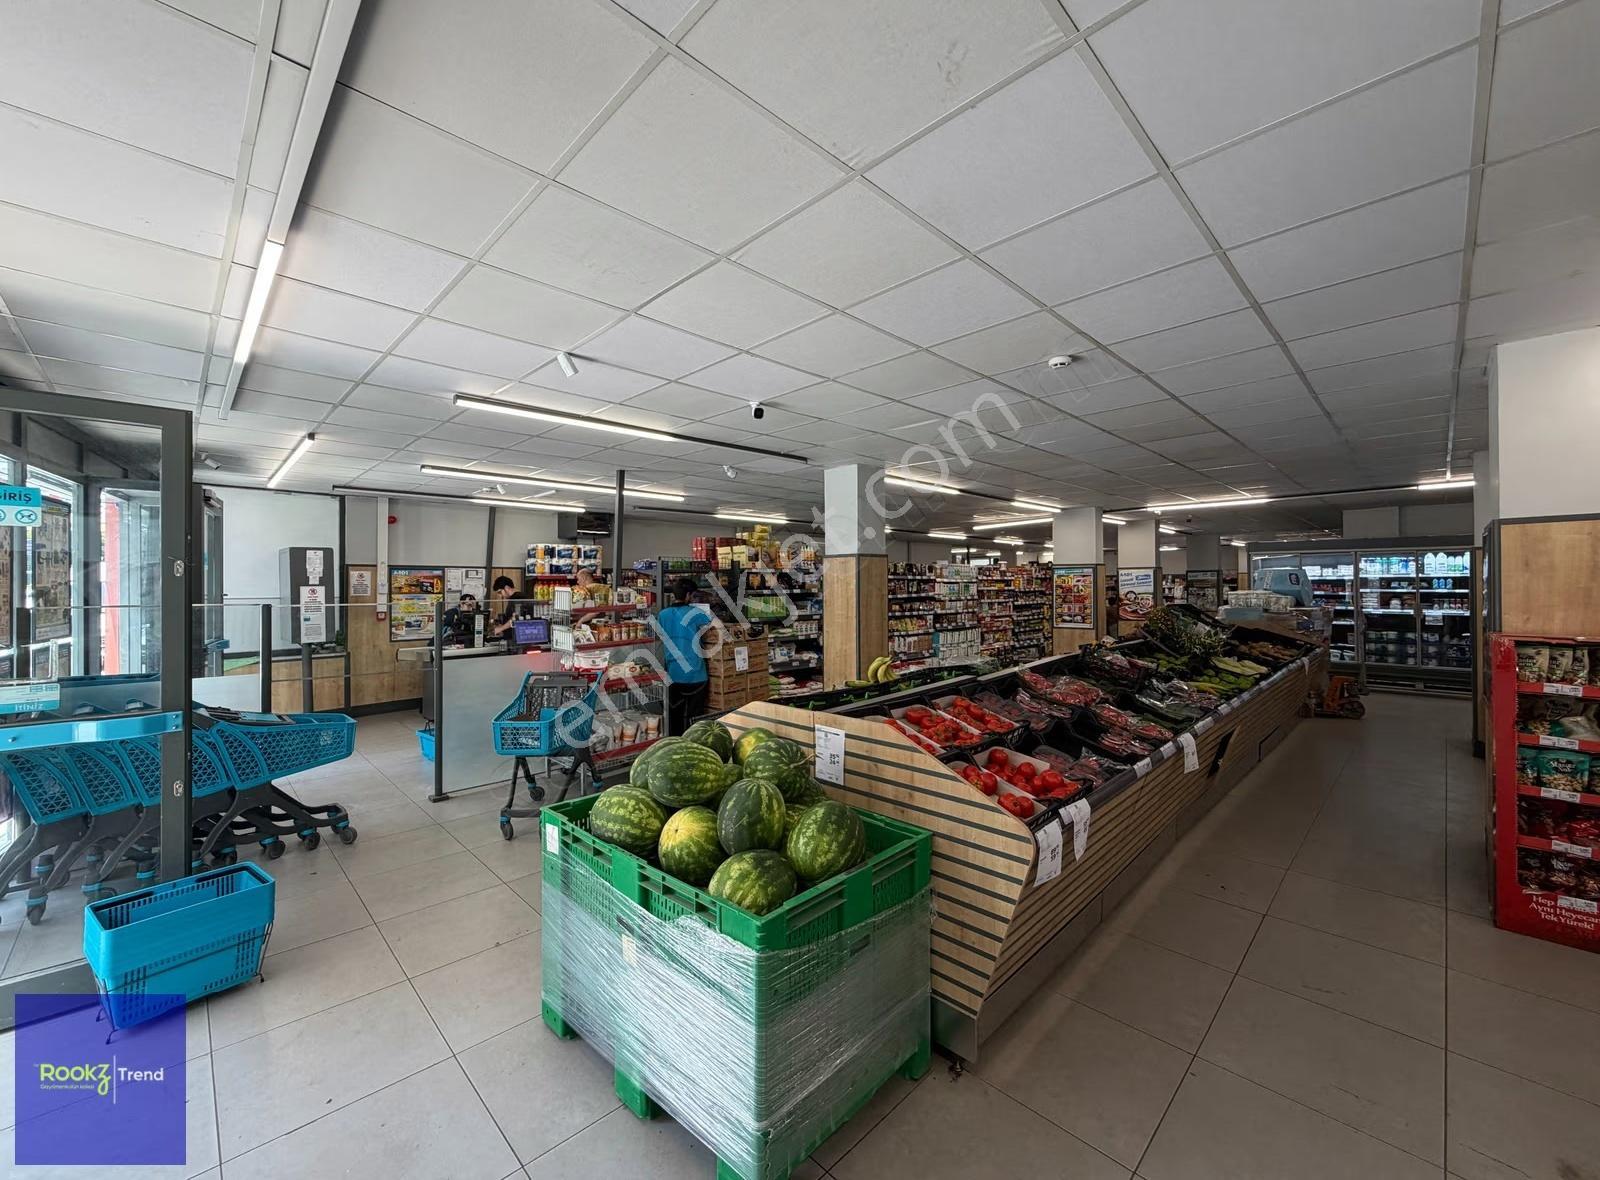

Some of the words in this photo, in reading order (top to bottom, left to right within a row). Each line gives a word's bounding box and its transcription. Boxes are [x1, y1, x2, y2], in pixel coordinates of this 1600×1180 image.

[0, 489, 32, 504] İRİŞ
[1532, 895, 1556, 907] Hep
[1540, 911, 1559, 922] Tek
